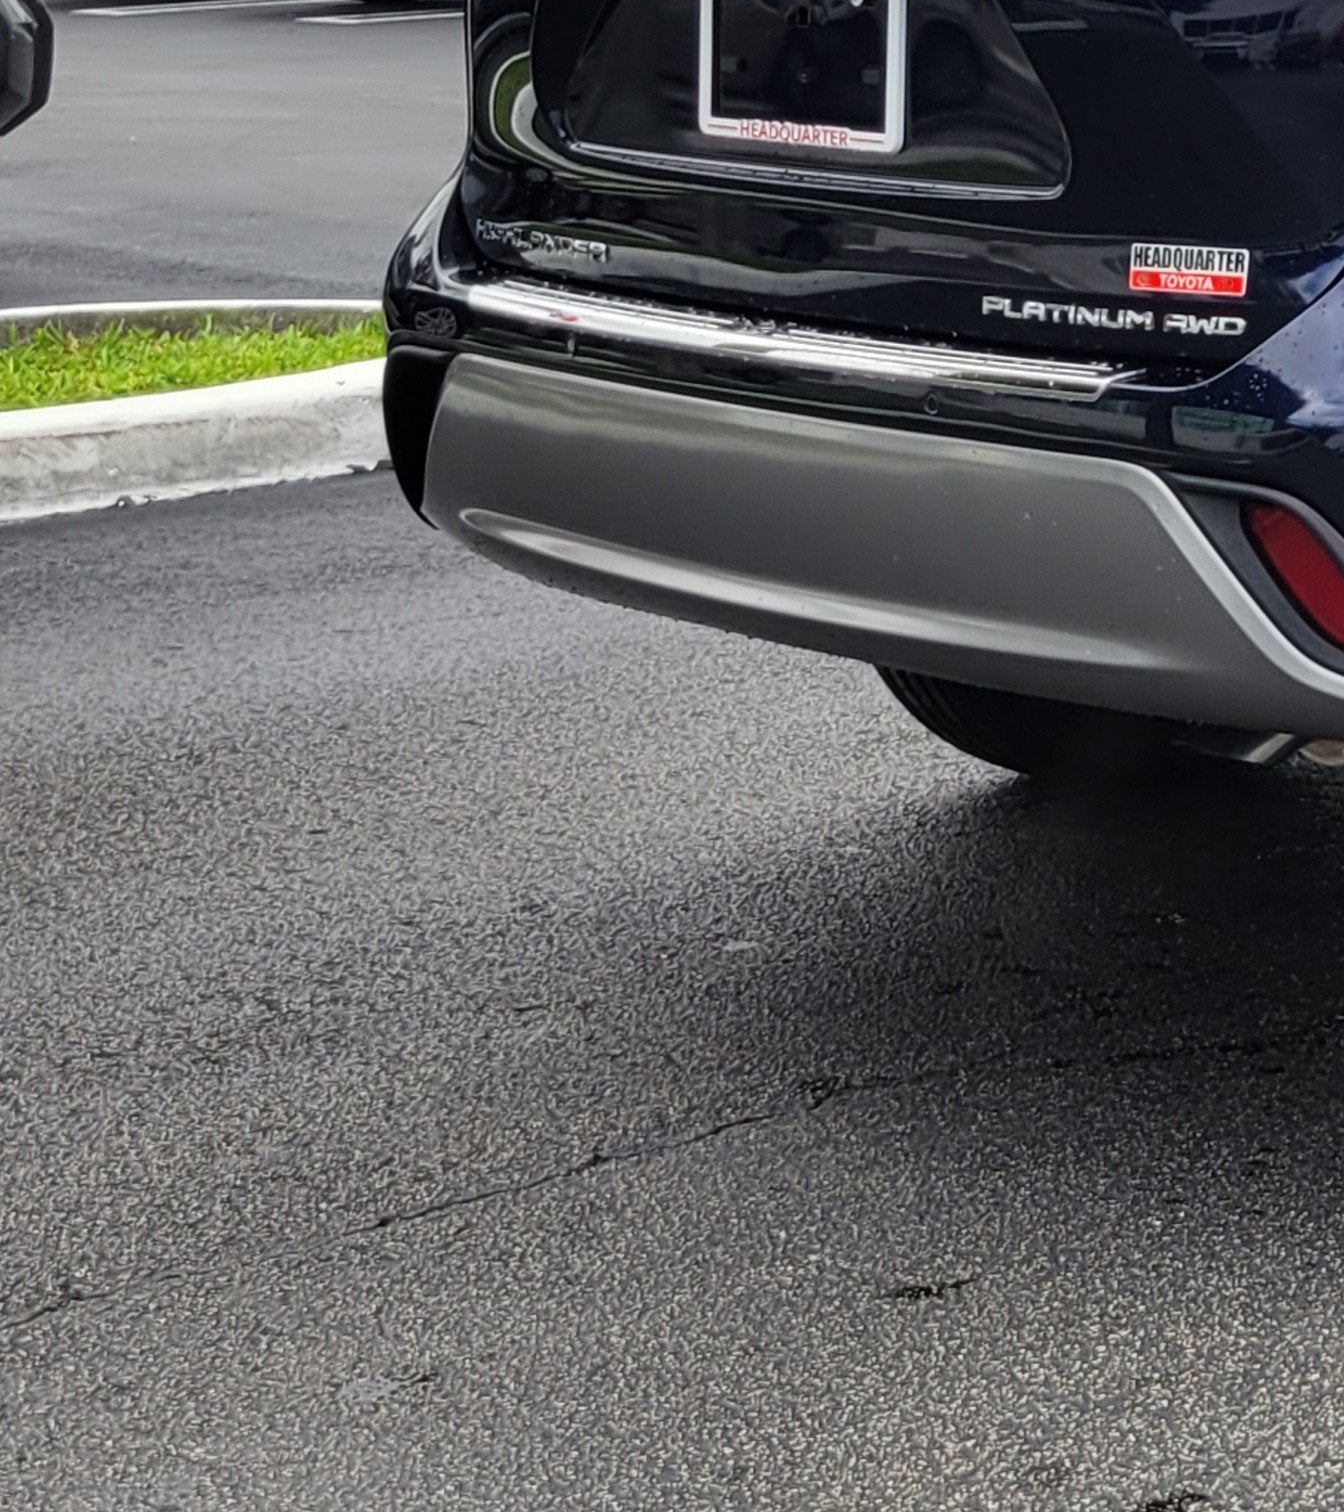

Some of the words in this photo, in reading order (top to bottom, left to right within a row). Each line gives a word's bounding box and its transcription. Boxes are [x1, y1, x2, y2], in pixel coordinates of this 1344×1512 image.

[740, 119, 848, 146] HEADQUARTER
[1133, 245, 1246, 273] HEADQUARTER
[1159, 273, 1213, 291] TOYOTA
[981, 295, 1155, 331] PLATINUM
[1163, 313, 1247, 336] AWD
